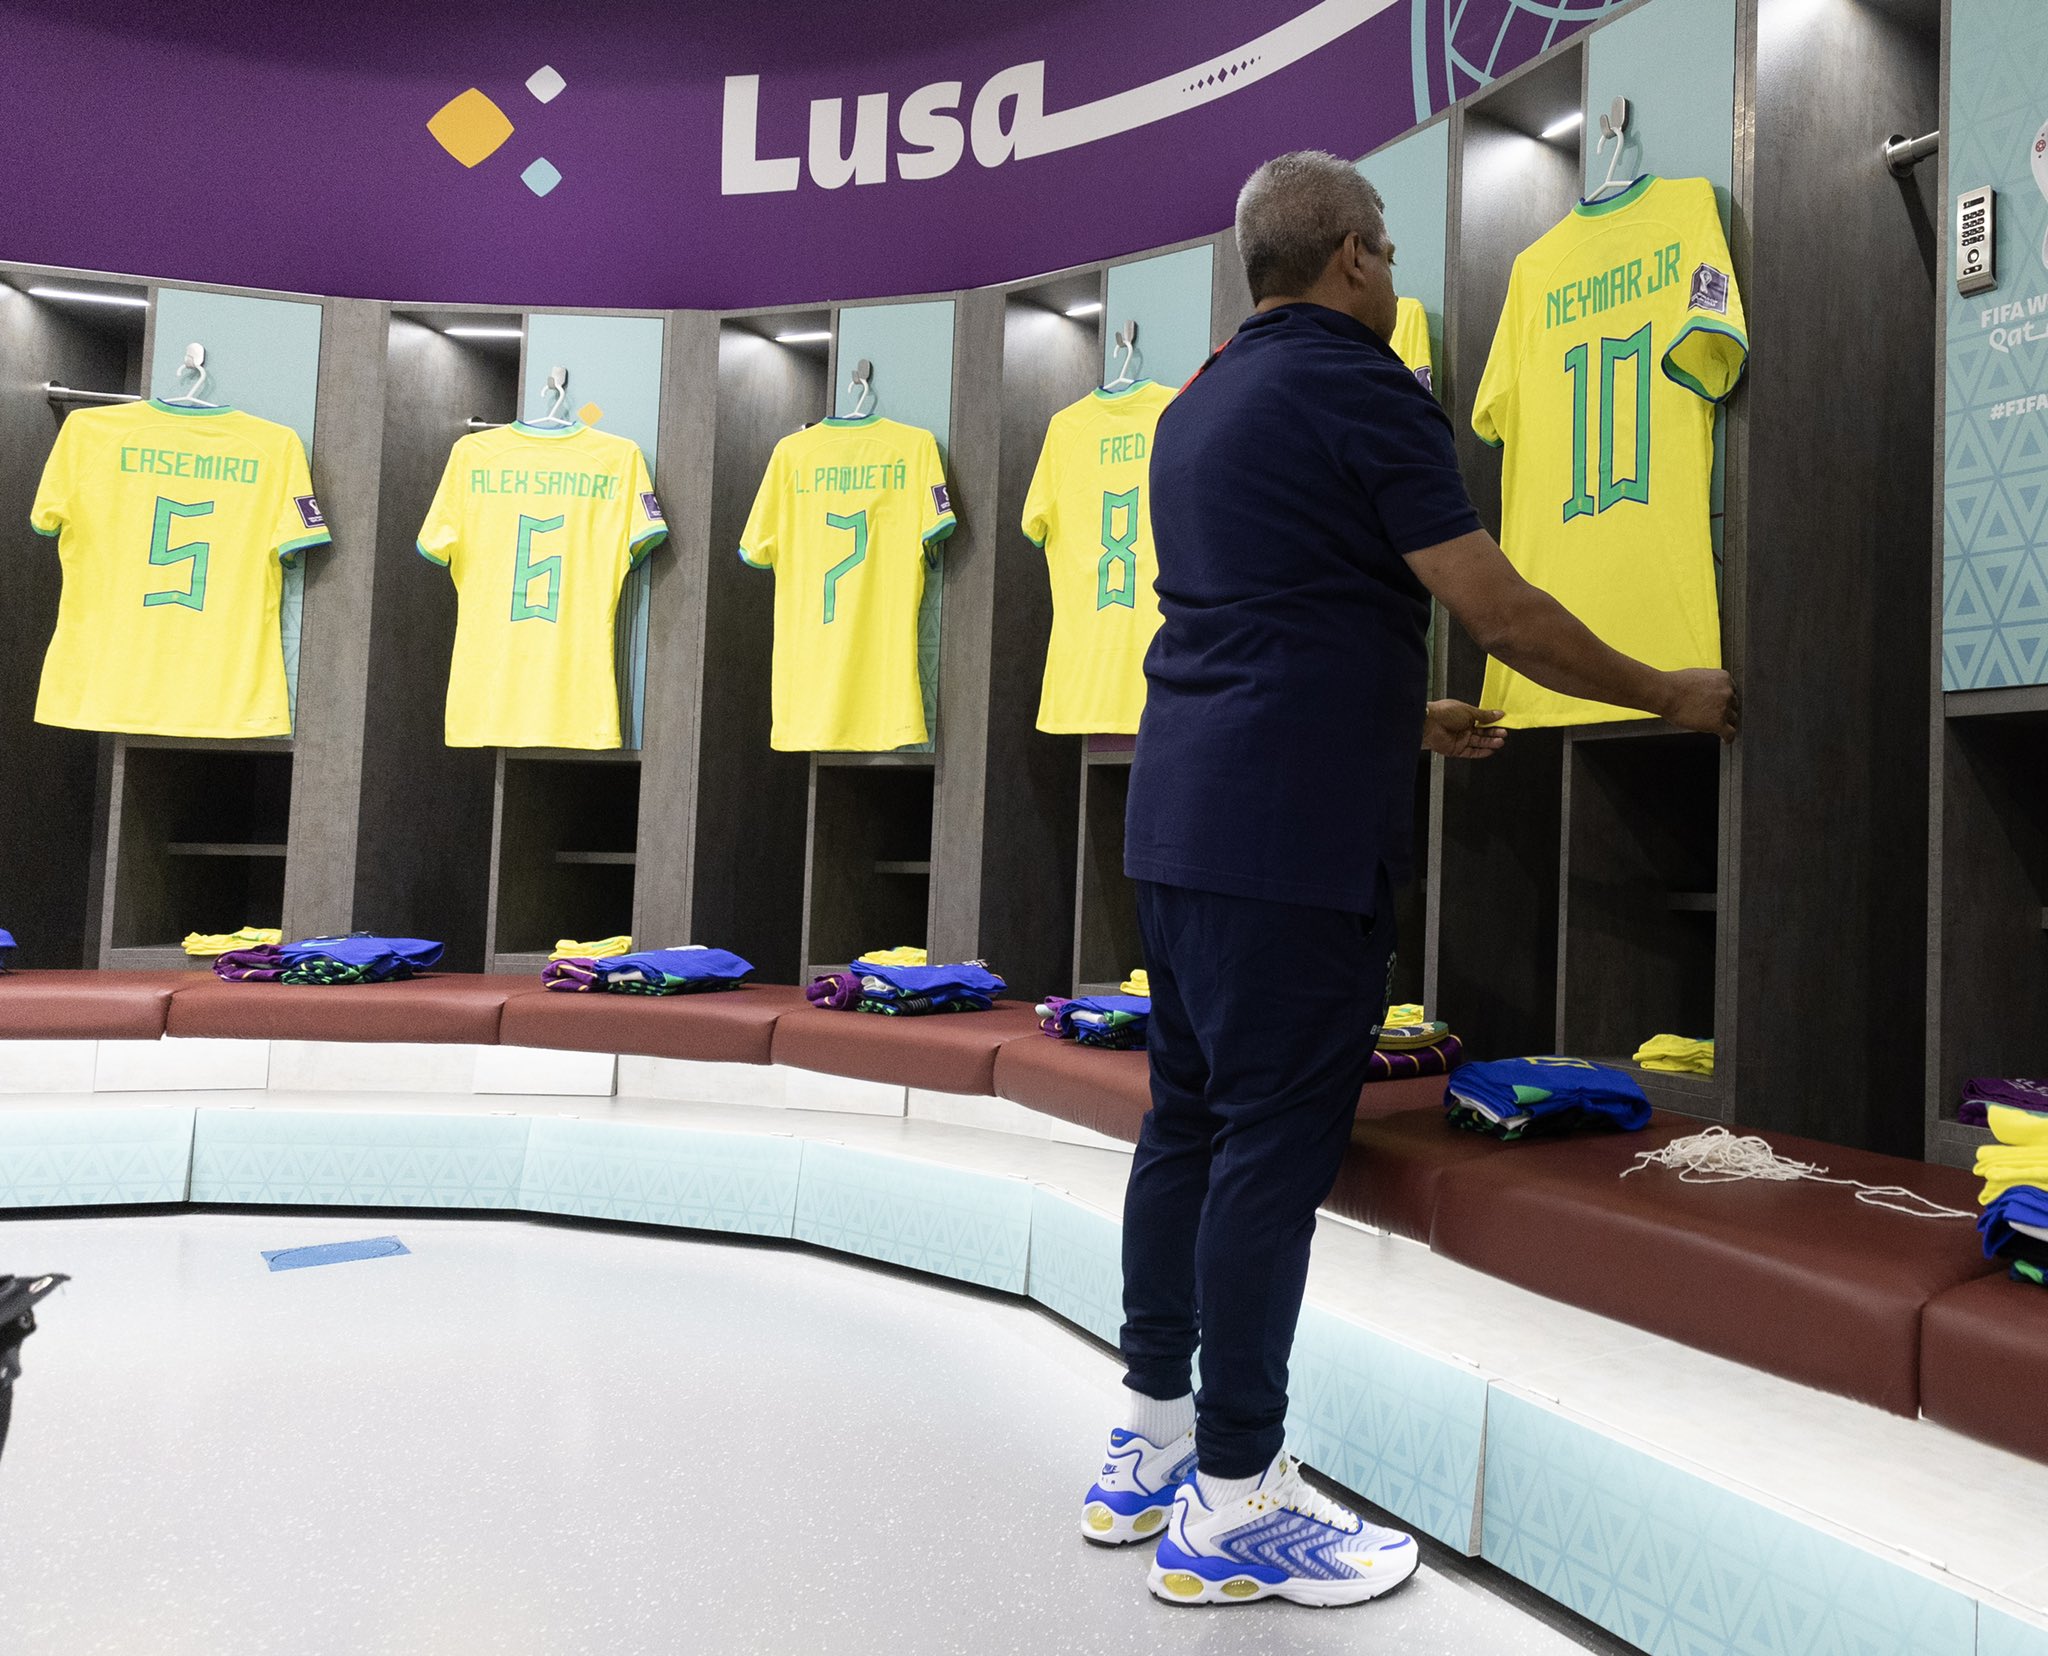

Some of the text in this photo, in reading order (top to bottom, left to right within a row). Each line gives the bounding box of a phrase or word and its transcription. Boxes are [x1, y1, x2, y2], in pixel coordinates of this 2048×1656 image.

[721, 60, 1045, 195] Lusa
[1546, 242, 1680, 329] NEYMAR JR
[1981, 301, 2025, 328] FIFA
[1989, 320, 2048, 353] Qat
[120, 446, 259, 484] CASEMIRO
[1100, 432, 1146, 465] FRED
[1563, 321, 1652, 524] 10
[471, 469, 529, 494] ALEX
[815, 458, 906, 494] PAQUETÁ
[143, 495, 215, 612] 5
[510, 513, 565, 624] 6
[823, 509, 868, 624] 7
[1096, 486, 1139, 611] 8
